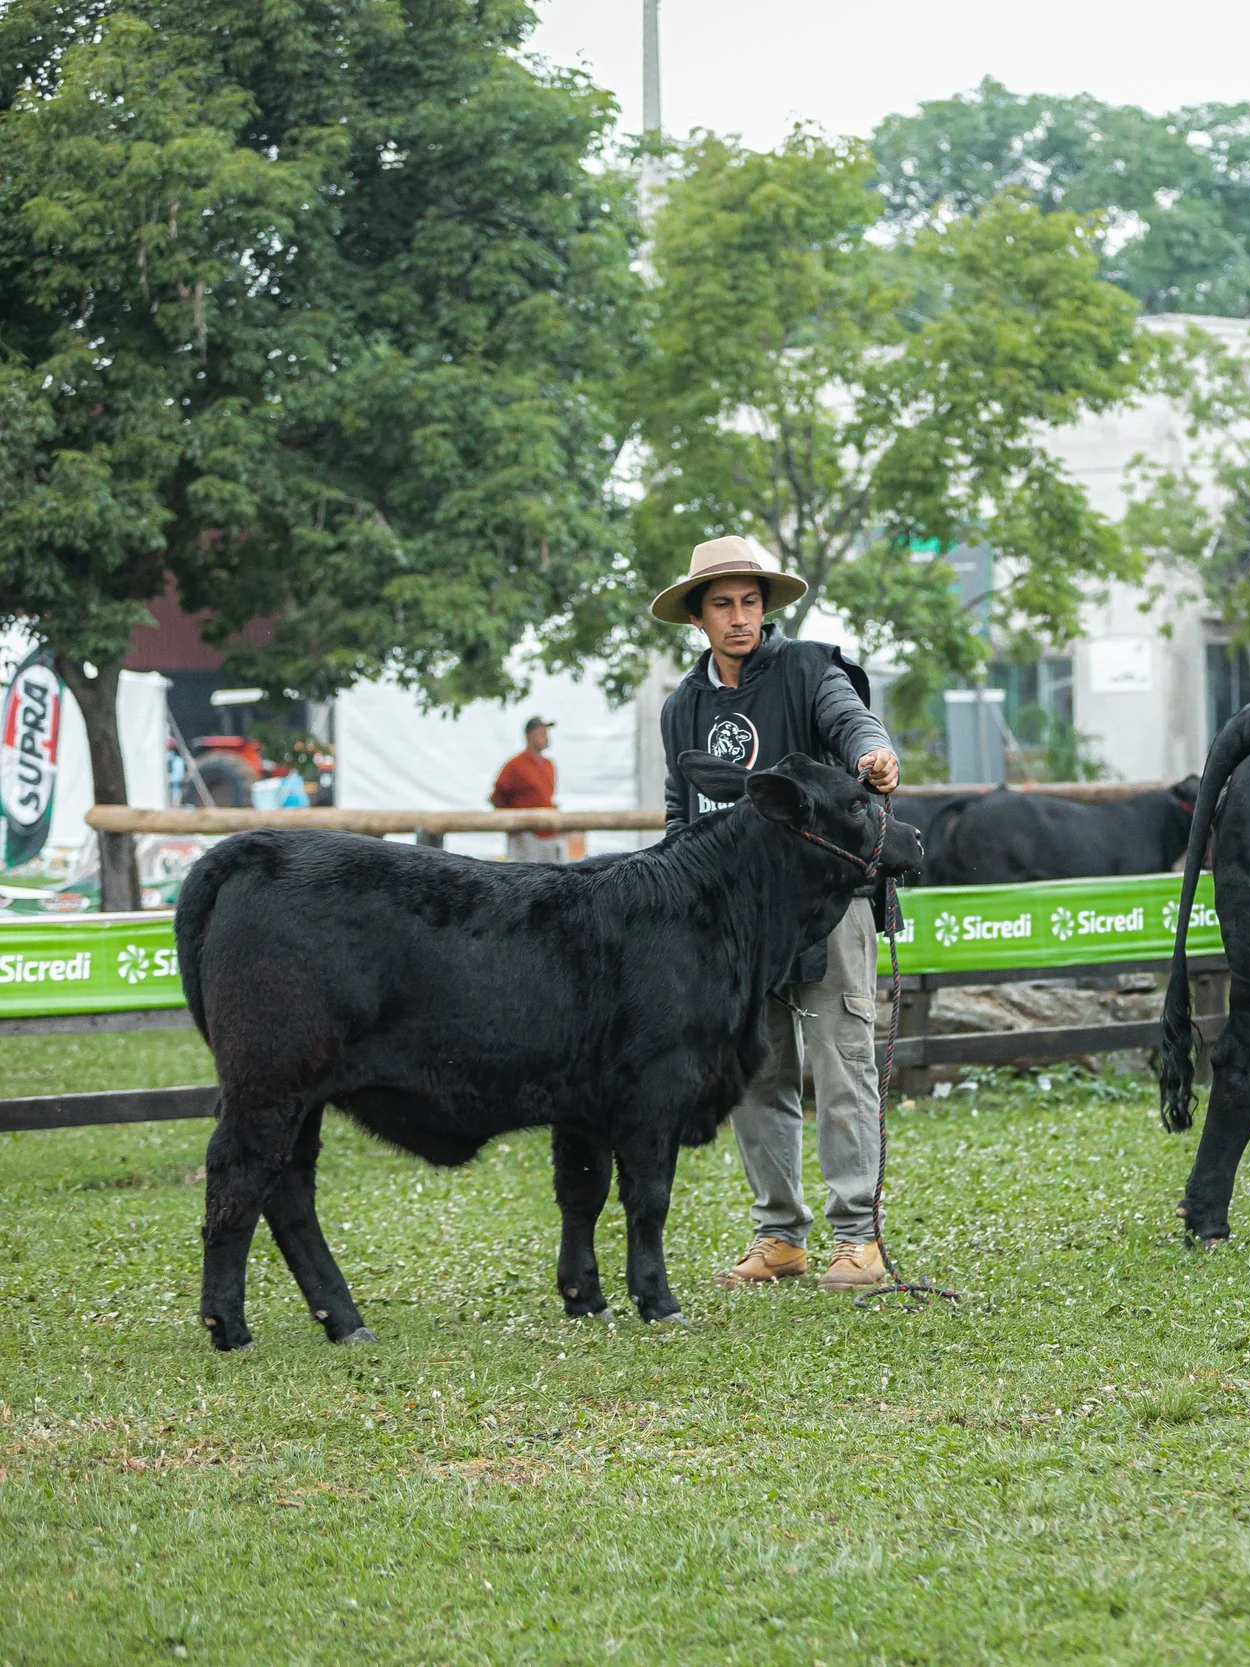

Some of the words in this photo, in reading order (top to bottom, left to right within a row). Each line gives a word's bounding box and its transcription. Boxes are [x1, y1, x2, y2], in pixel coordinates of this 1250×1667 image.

[18, 680, 49, 812] SUPRA
[962, 913, 1032, 941] Sicredi
[1077, 907, 1145, 935] Sicredi
[0, 952, 92, 983] Sicredi
